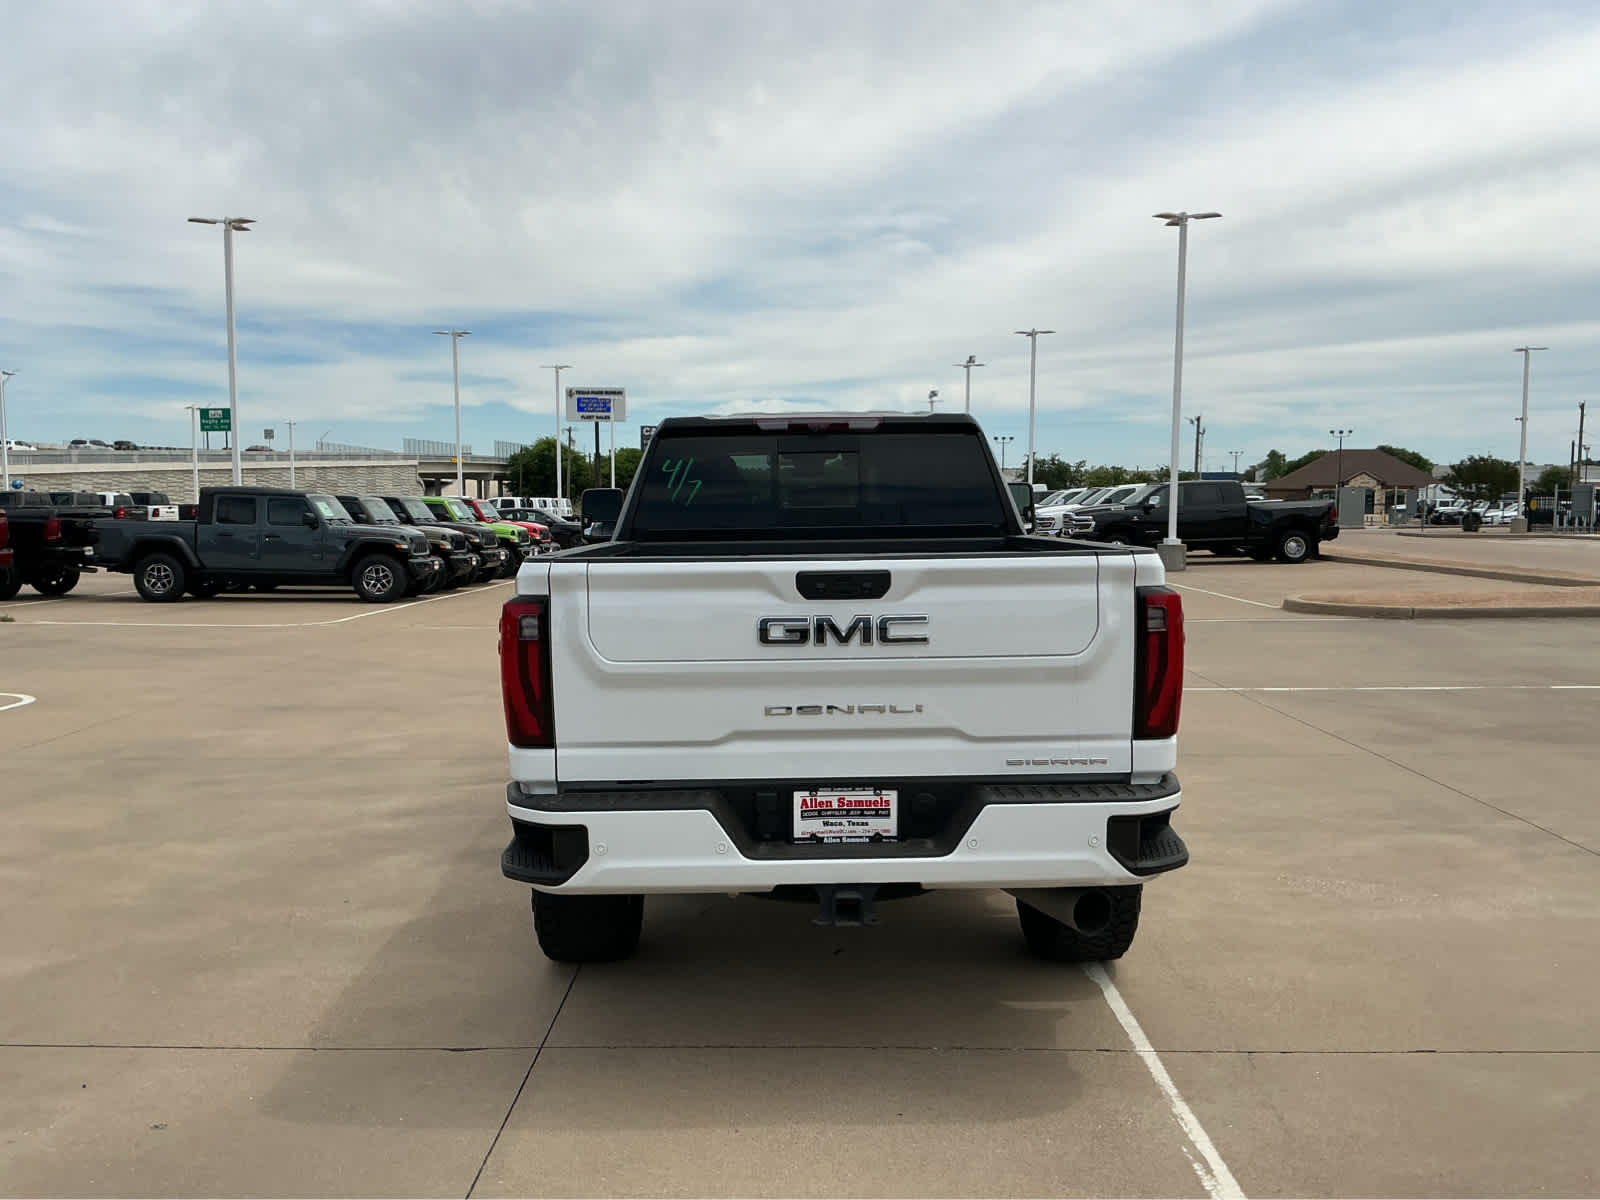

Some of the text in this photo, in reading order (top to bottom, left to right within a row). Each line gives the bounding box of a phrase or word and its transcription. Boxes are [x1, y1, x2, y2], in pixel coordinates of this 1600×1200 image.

[758, 614, 930, 647] GMC
[764, 703, 924, 717] DENALI
[1006, 758, 1108, 766] SIERRA
[800, 797, 891, 809] Allen Samuels
